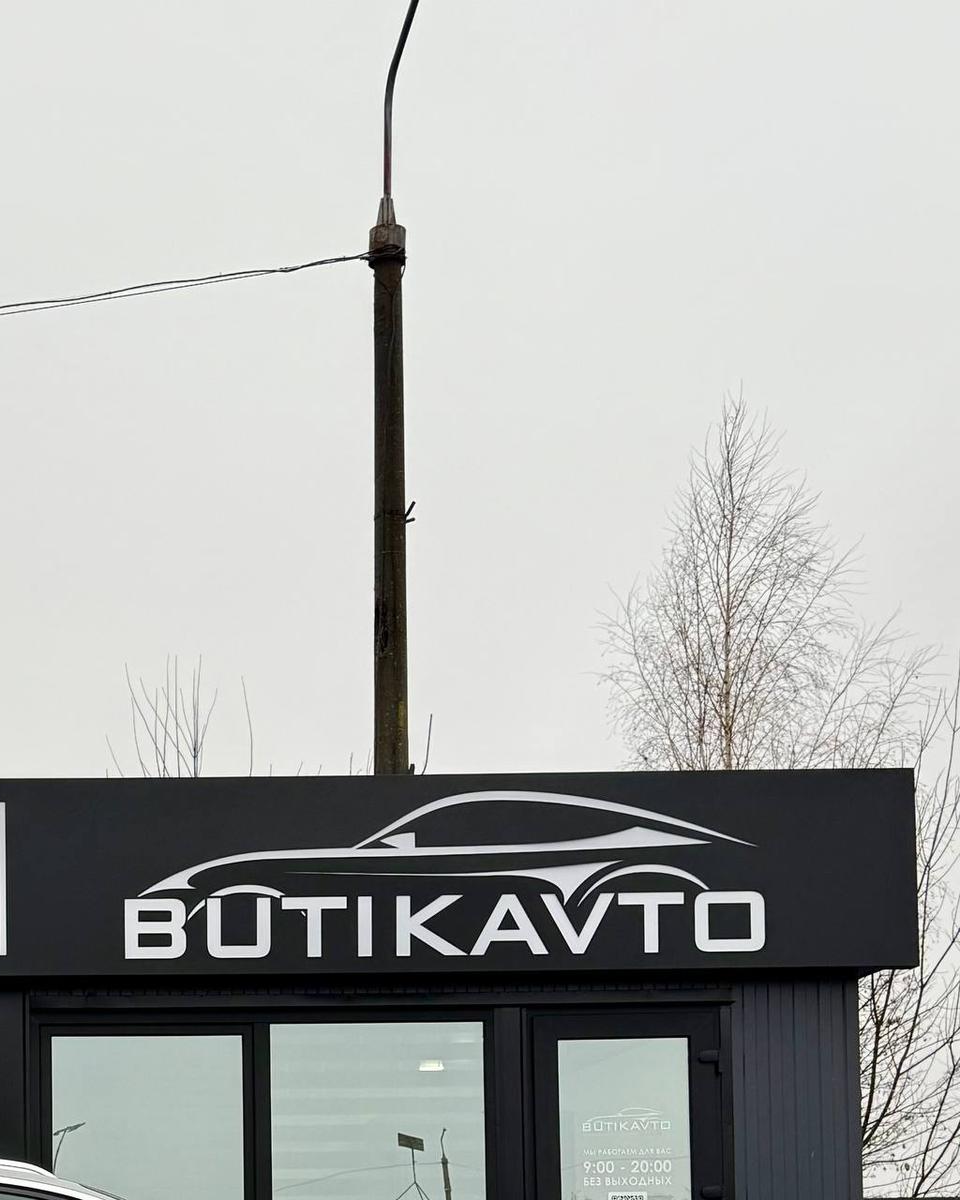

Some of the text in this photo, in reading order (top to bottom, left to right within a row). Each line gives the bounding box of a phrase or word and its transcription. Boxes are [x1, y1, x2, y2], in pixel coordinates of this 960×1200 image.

[123, 890, 766, 960] BUTIKAVTO
[583, 1121, 671, 1131] BUTIKAVTO
[584, 1161, 614, 1173] 9:00
[631, 1160, 671, 1173] 20:00
[584, 1176, 671, 1185] БЕЗ ВЫХОДНЫХ
